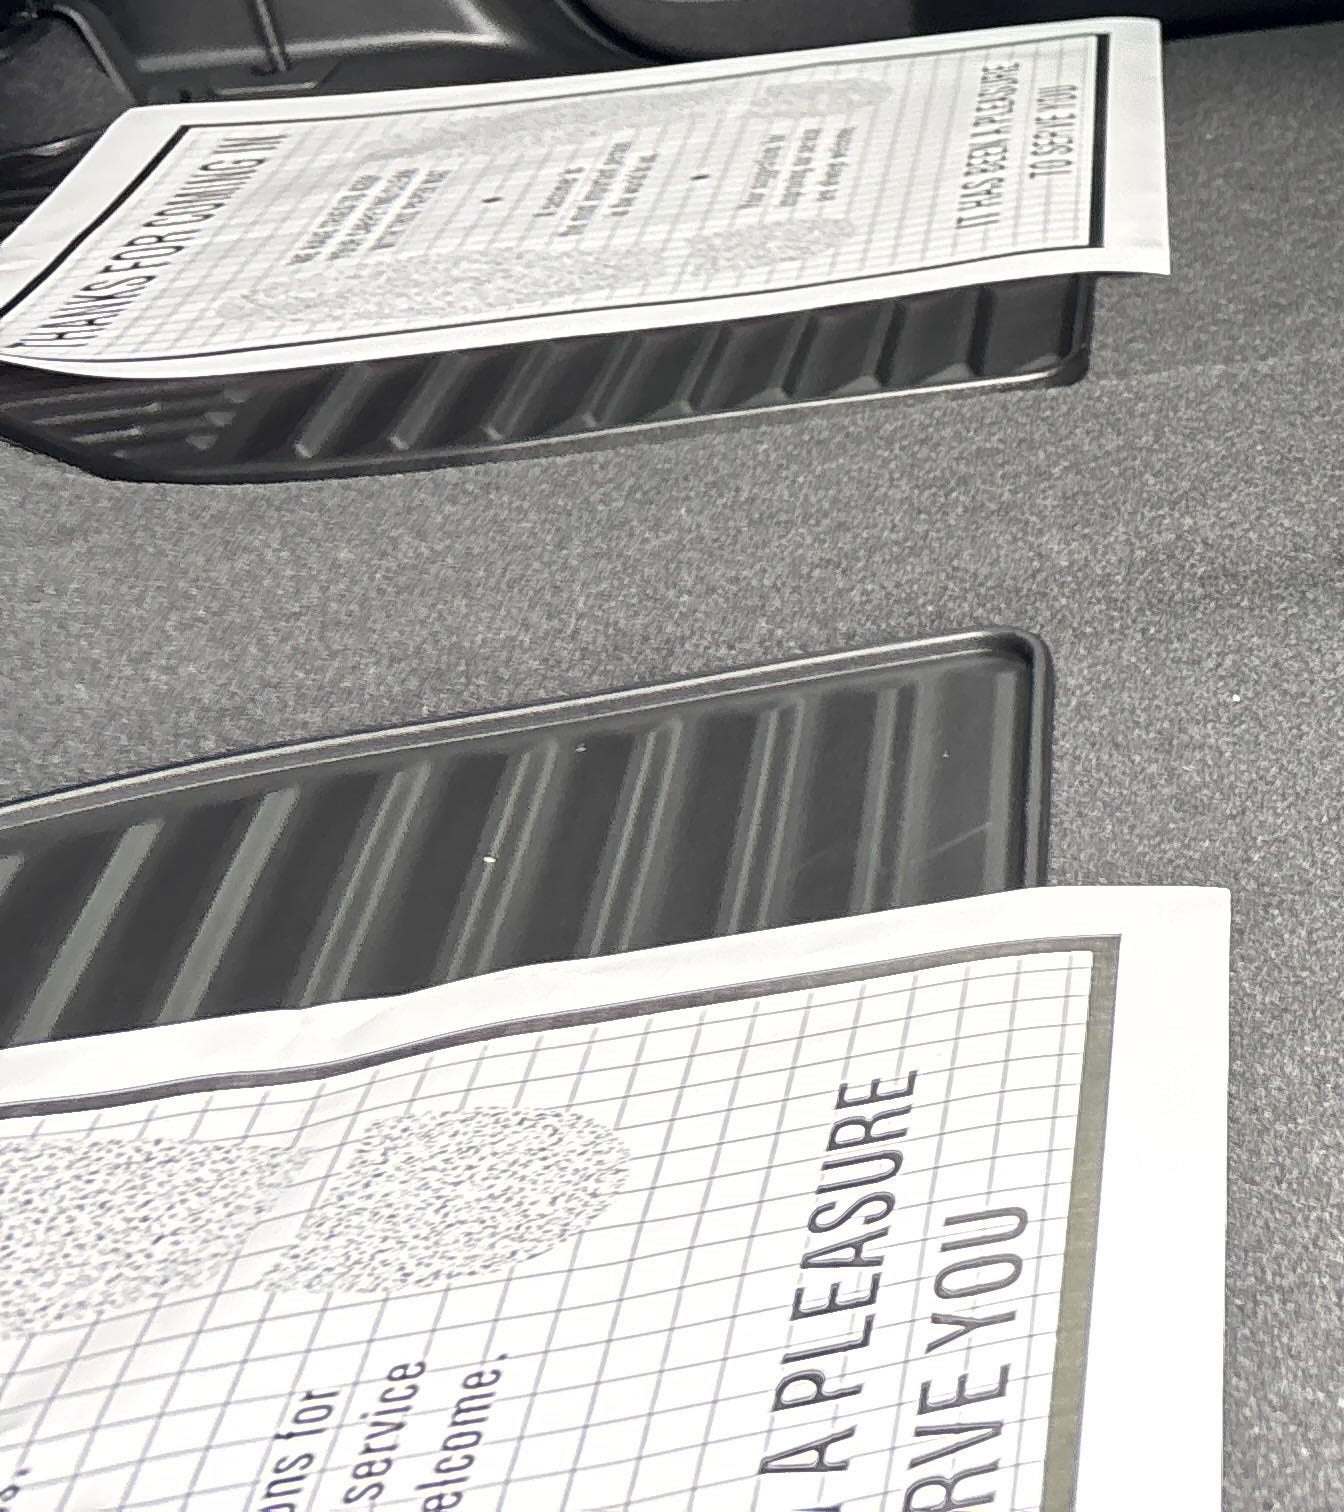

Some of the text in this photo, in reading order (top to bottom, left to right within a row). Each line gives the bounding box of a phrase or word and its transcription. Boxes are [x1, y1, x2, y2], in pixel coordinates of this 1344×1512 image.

[954, 63, 1020, 230] IT HAS BEEN A PLEASURE
[1028, 84, 1078, 179] TO SERVE YOU
[4, 135, 289, 348] THANKS FOR COMING IN
[771, 1069, 920, 1413] PLEASURE
[273, 1388, 339, 1440] for
[344, 1360, 427, 1505] service
[415, 1353, 508, 1512] elcome.
[903, 1206, 1029, 1512] RVE YOU
[757, 1425, 858, 1475] A
